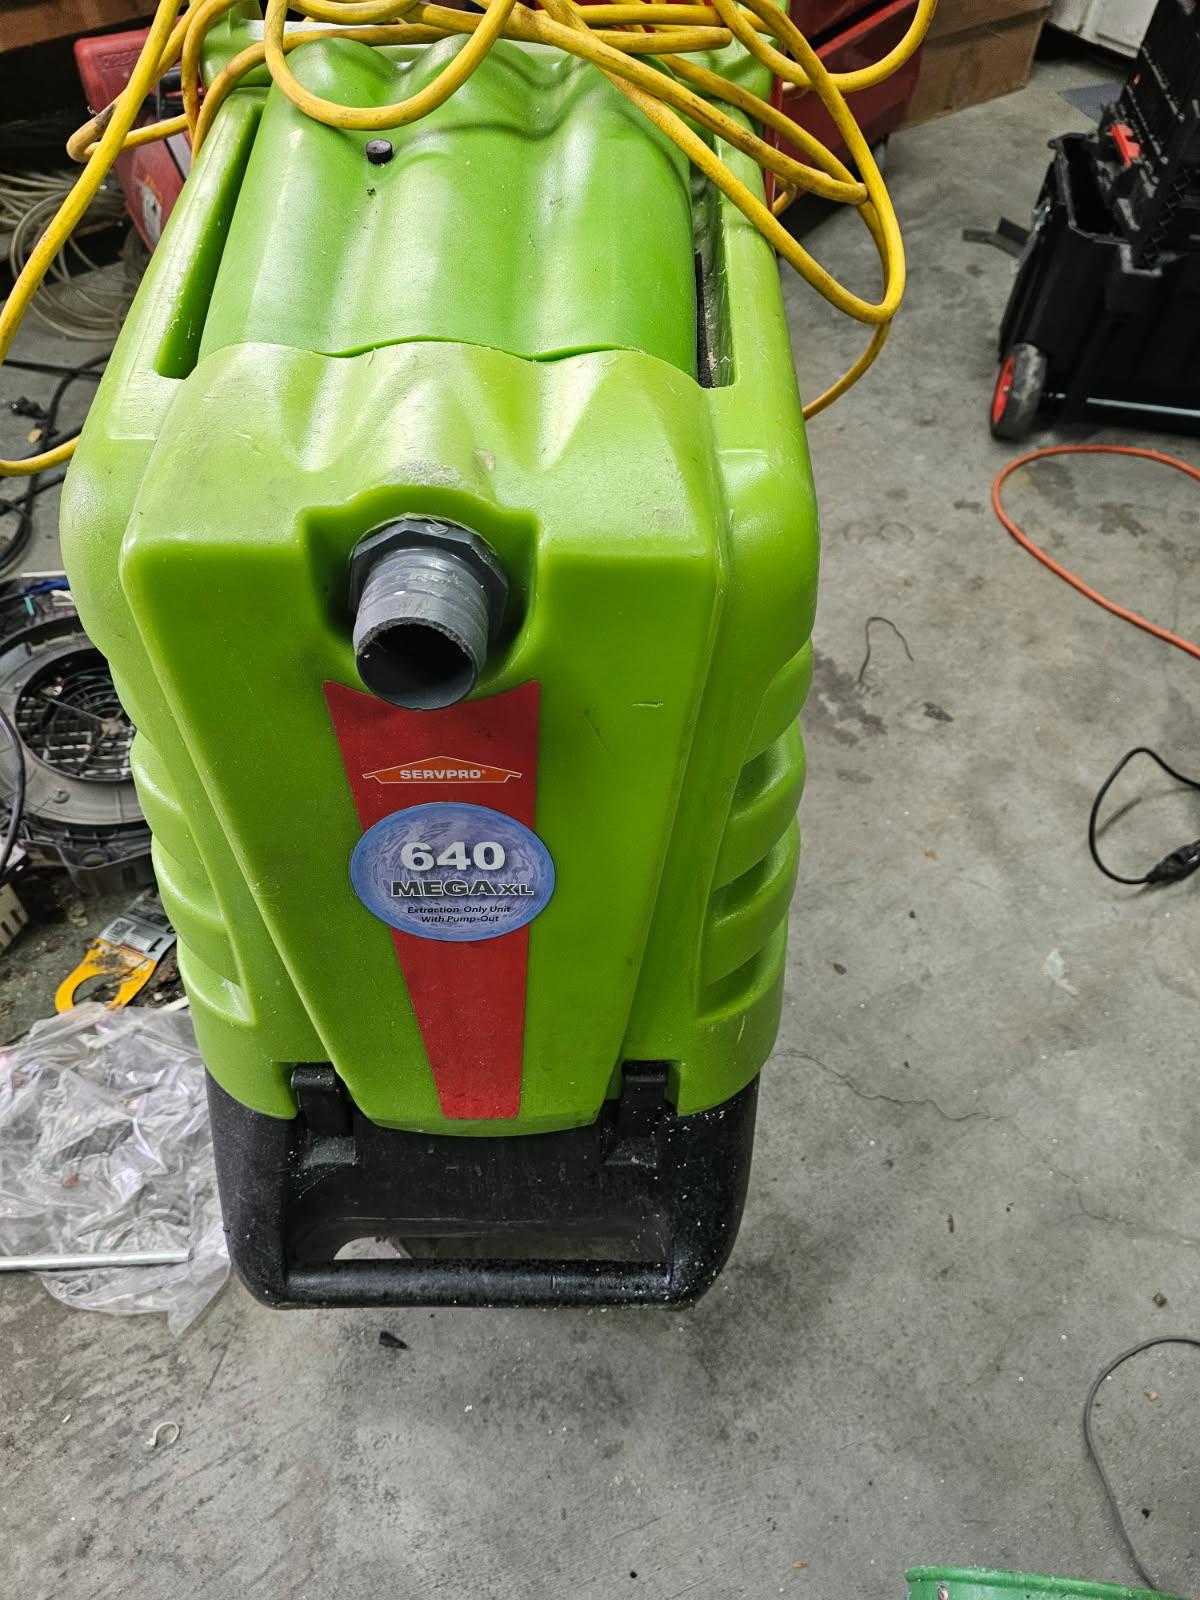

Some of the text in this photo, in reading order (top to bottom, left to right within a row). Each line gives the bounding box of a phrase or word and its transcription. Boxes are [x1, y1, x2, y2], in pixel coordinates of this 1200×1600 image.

[400, 841, 506, 871] 640
[391, 879, 534, 897] MEGA XL
[489, 905, 512, 913] Unit
[446, 915, 499, 924] Pump-Out
